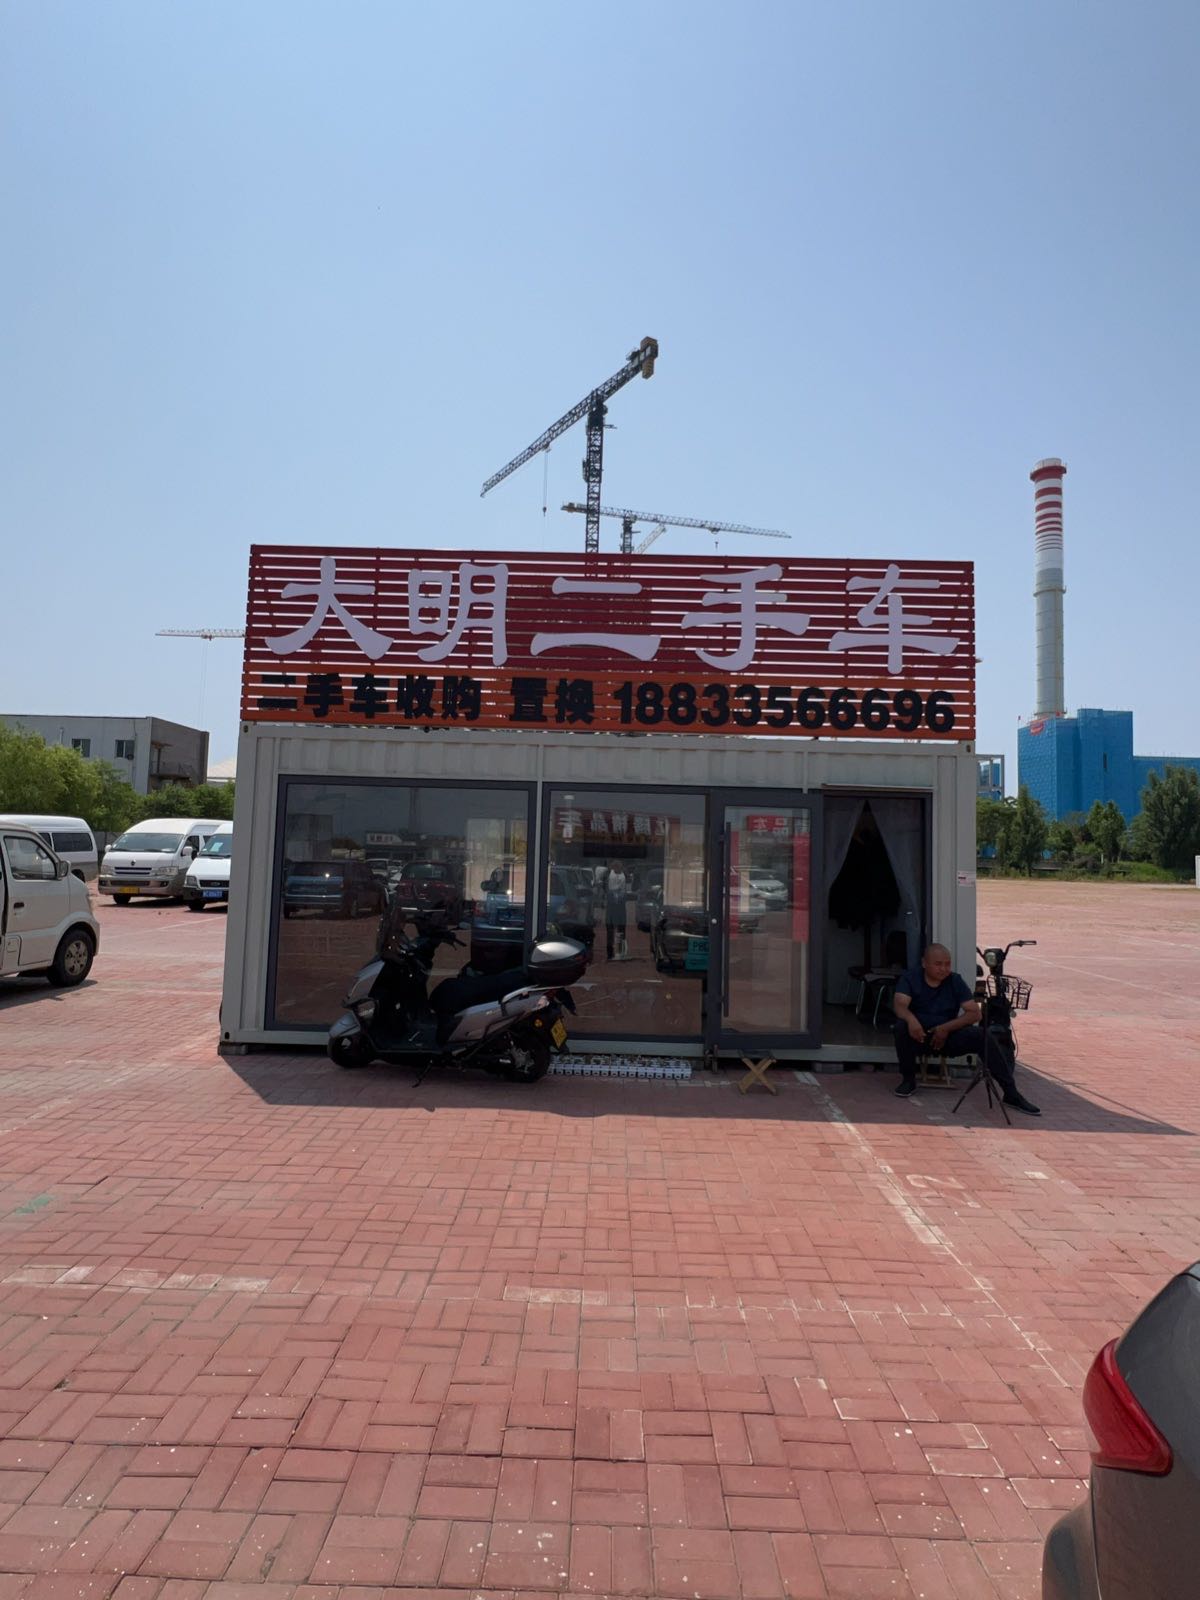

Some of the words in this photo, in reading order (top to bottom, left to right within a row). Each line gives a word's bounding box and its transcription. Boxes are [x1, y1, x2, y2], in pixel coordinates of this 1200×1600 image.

[264, 555, 961, 676] 大明二手车
[257, 673, 482, 721] 二手车收购
[509, 677, 595, 724] 置换
[613, 681, 956, 733] 18833566696
